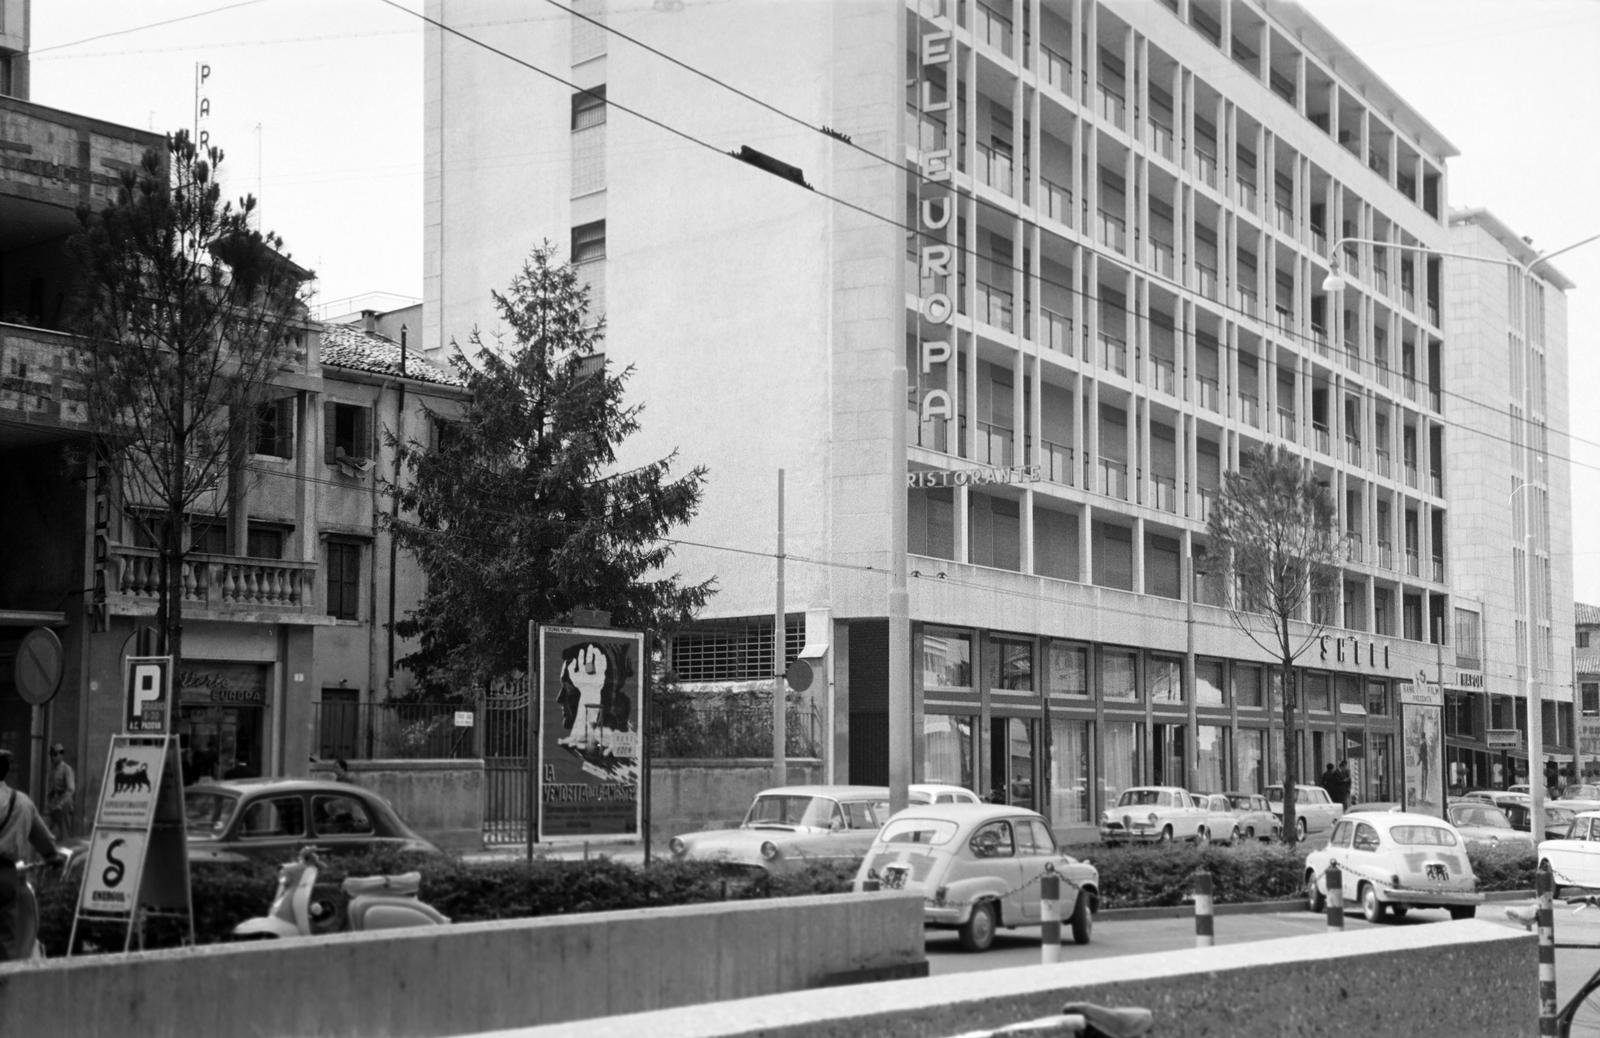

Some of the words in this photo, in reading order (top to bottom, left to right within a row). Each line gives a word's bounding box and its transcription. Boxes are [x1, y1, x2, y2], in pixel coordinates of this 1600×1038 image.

[922, 0, 953, 113] EL
[921, 148, 953, 423] EUROPA
[906, 465, 1041, 488] RISTORANTE
[133, 665, 161, 716] P
[210, 690, 261, 702] EUROPA
[141, 721, 162, 730] PADOVA
[543, 783, 589, 802] VENDETTA
